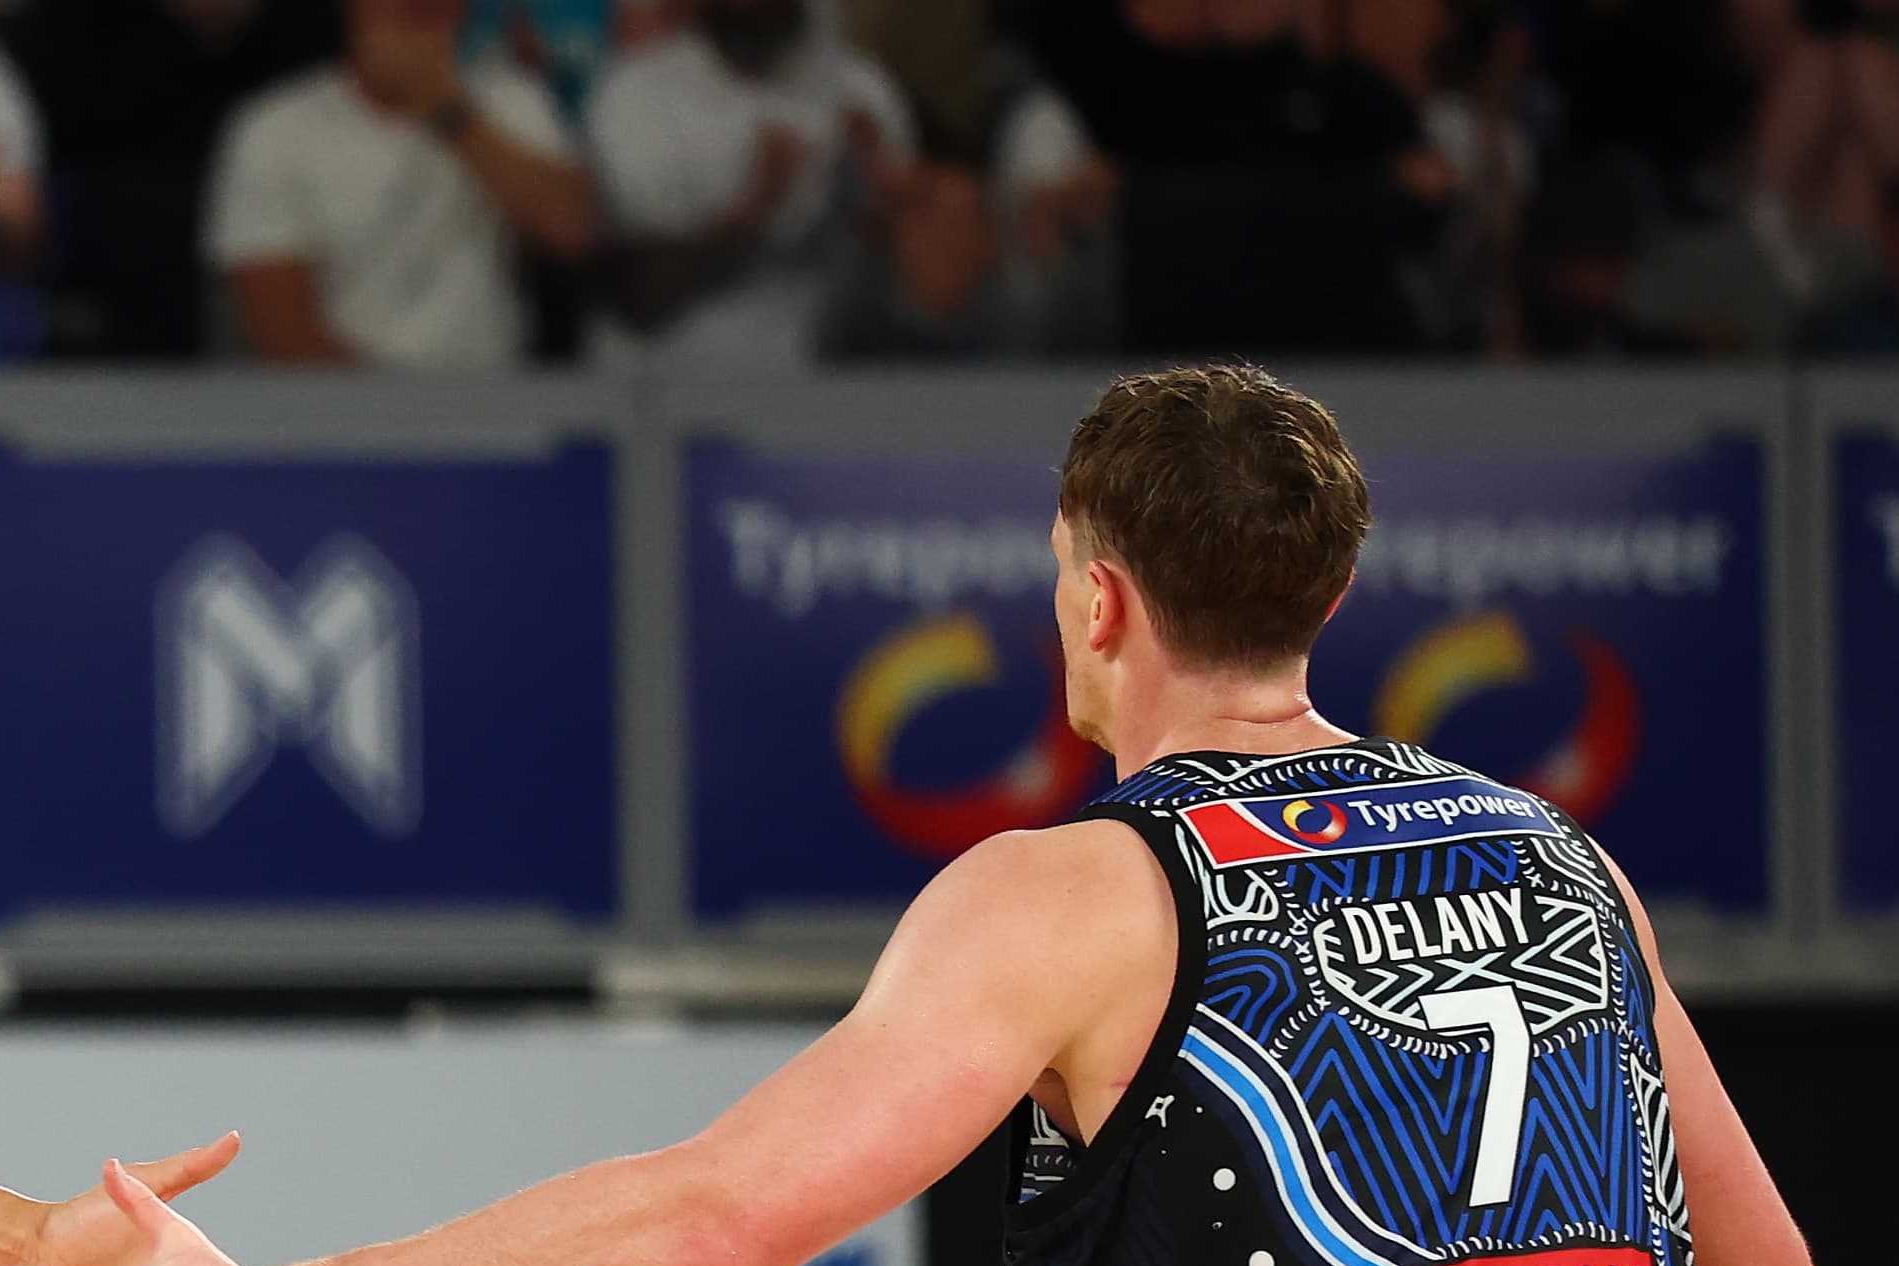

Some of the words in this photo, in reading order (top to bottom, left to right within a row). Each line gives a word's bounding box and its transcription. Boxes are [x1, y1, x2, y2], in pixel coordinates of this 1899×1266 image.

[1347, 793, 1537, 833] Tyrepower
[1340, 887, 1530, 966] DELANY
[1417, 983, 1533, 1208] 7
